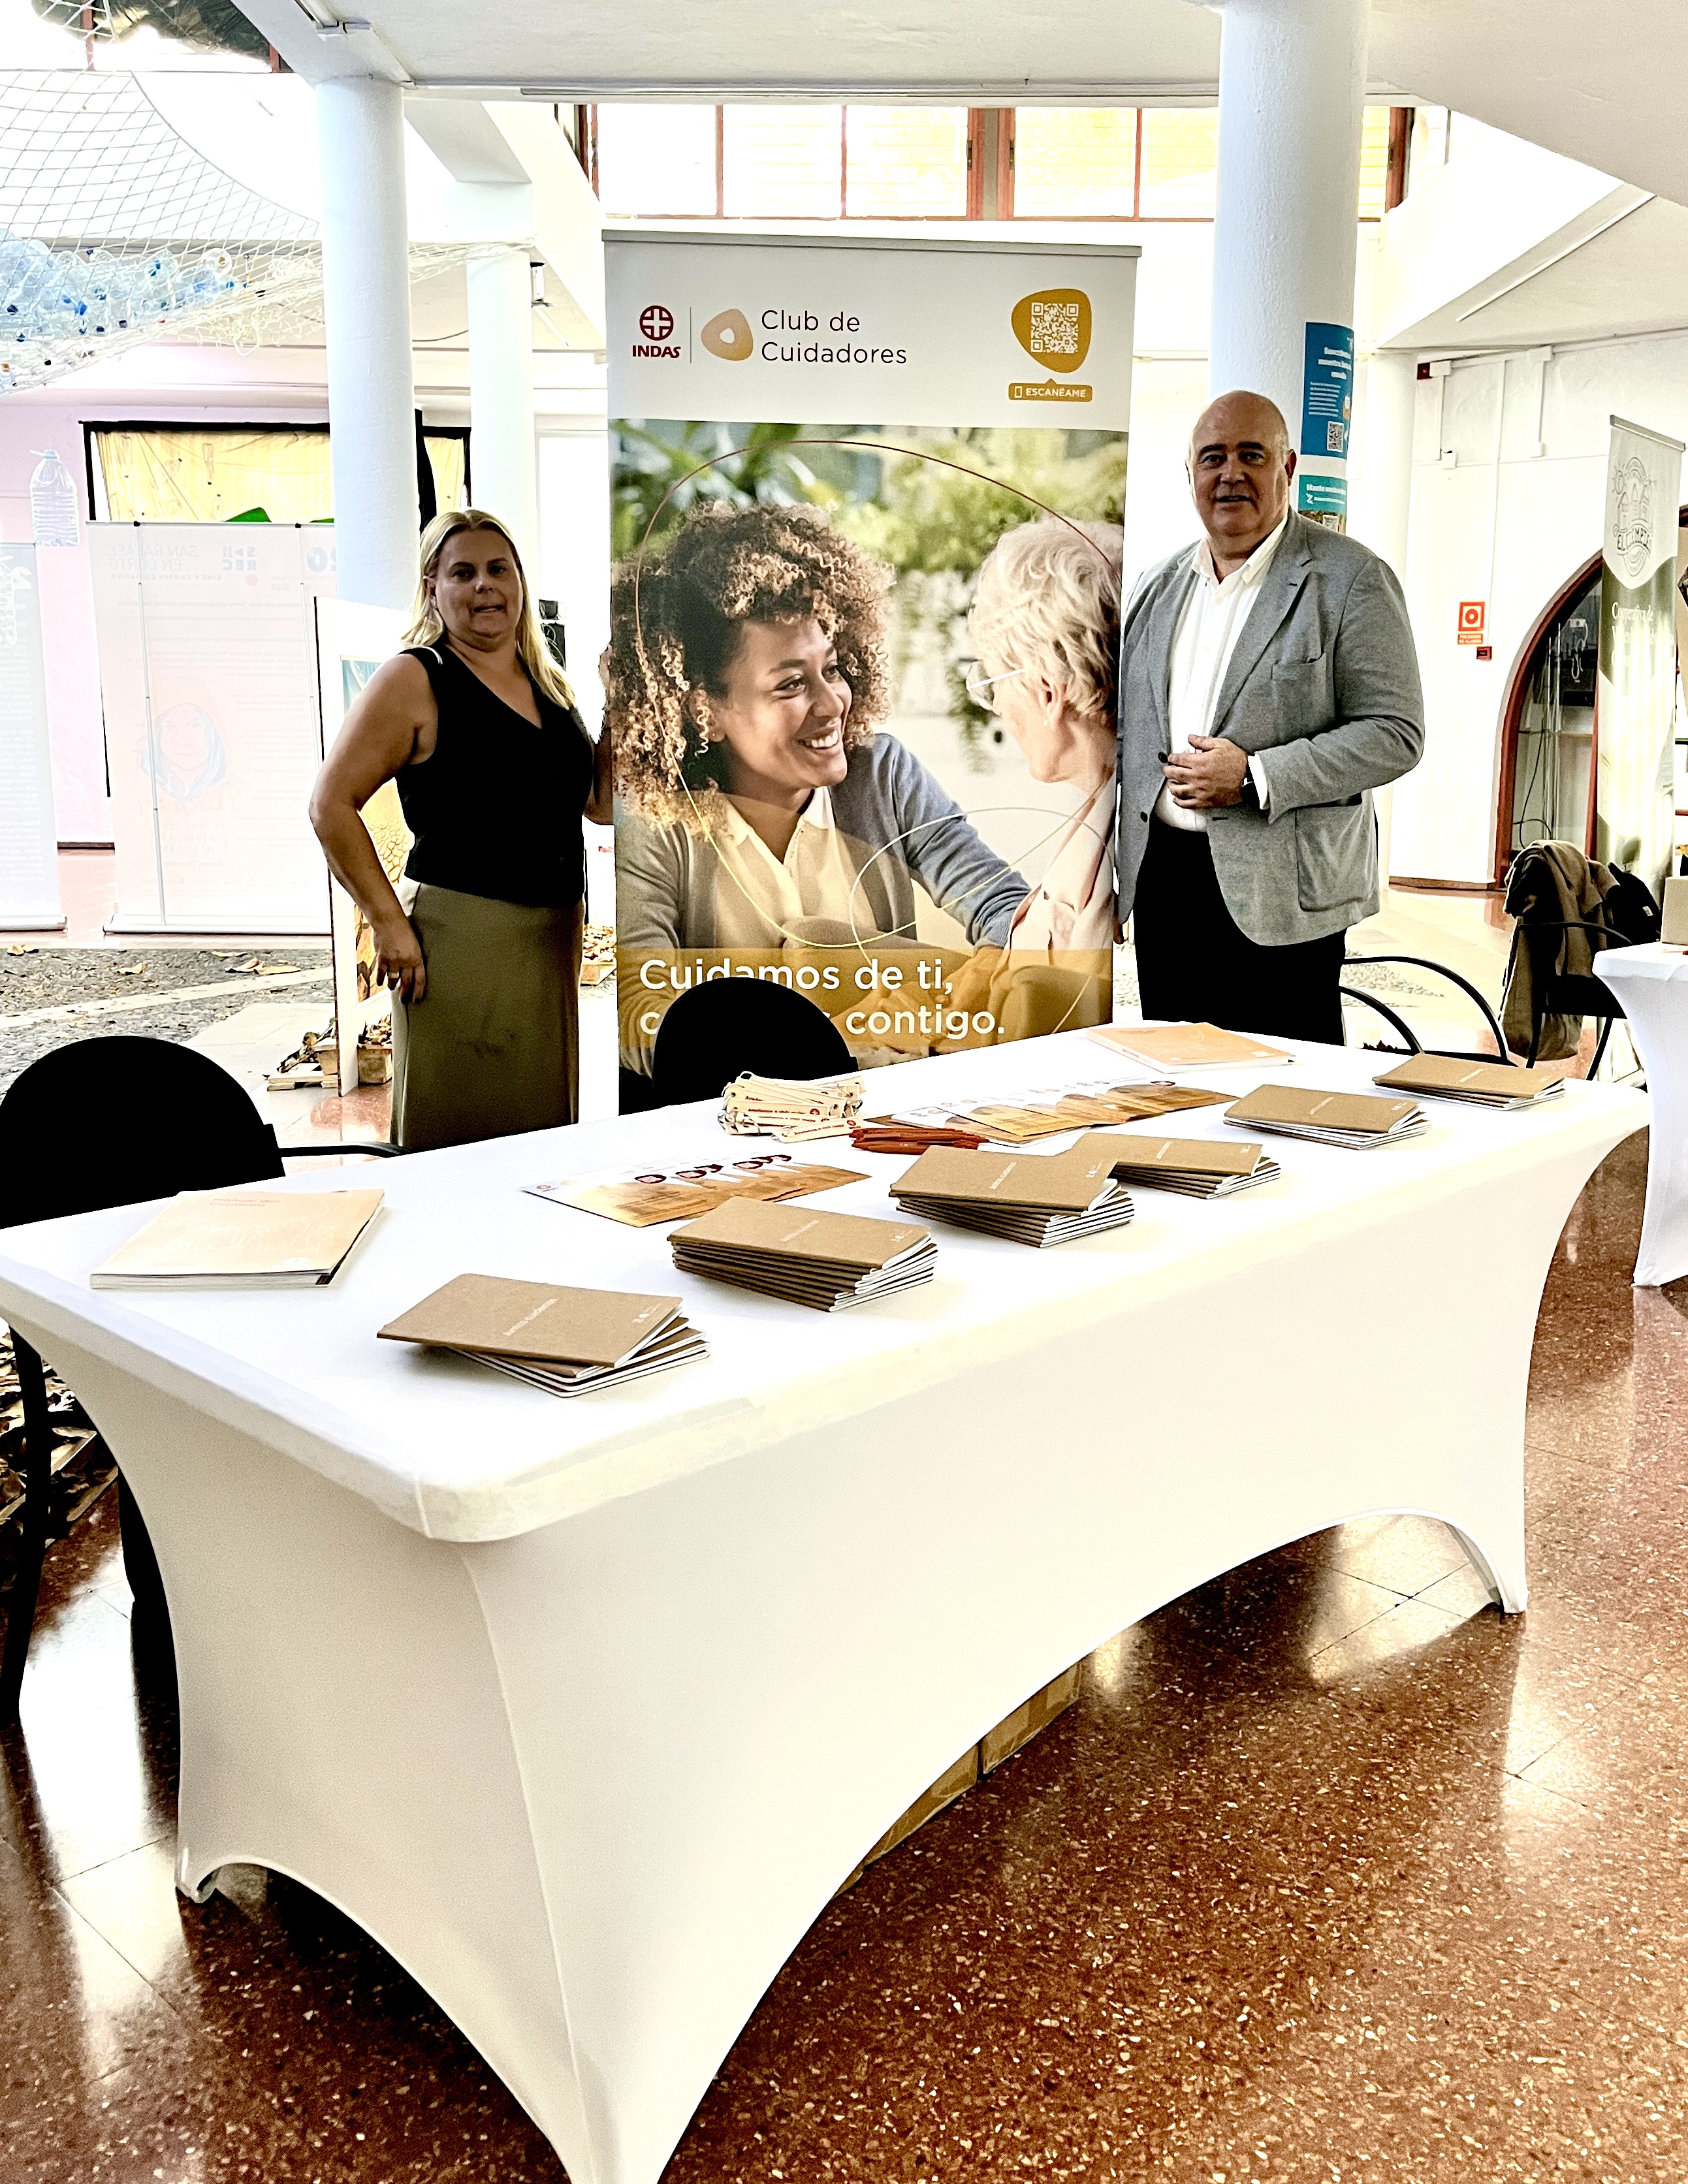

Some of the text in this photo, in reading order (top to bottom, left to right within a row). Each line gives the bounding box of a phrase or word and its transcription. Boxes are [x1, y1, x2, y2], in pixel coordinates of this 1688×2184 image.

[761, 309, 860, 332] Club de
[632, 345, 681, 358] INDAS
[761, 341, 907, 364] Cuidadores
[1025, 387, 1086, 398] ESCANÉAME
[853, 958, 903, 990] de
[916, 958, 953, 994] ti,
[846, 1004, 1005, 1039] contigo.
